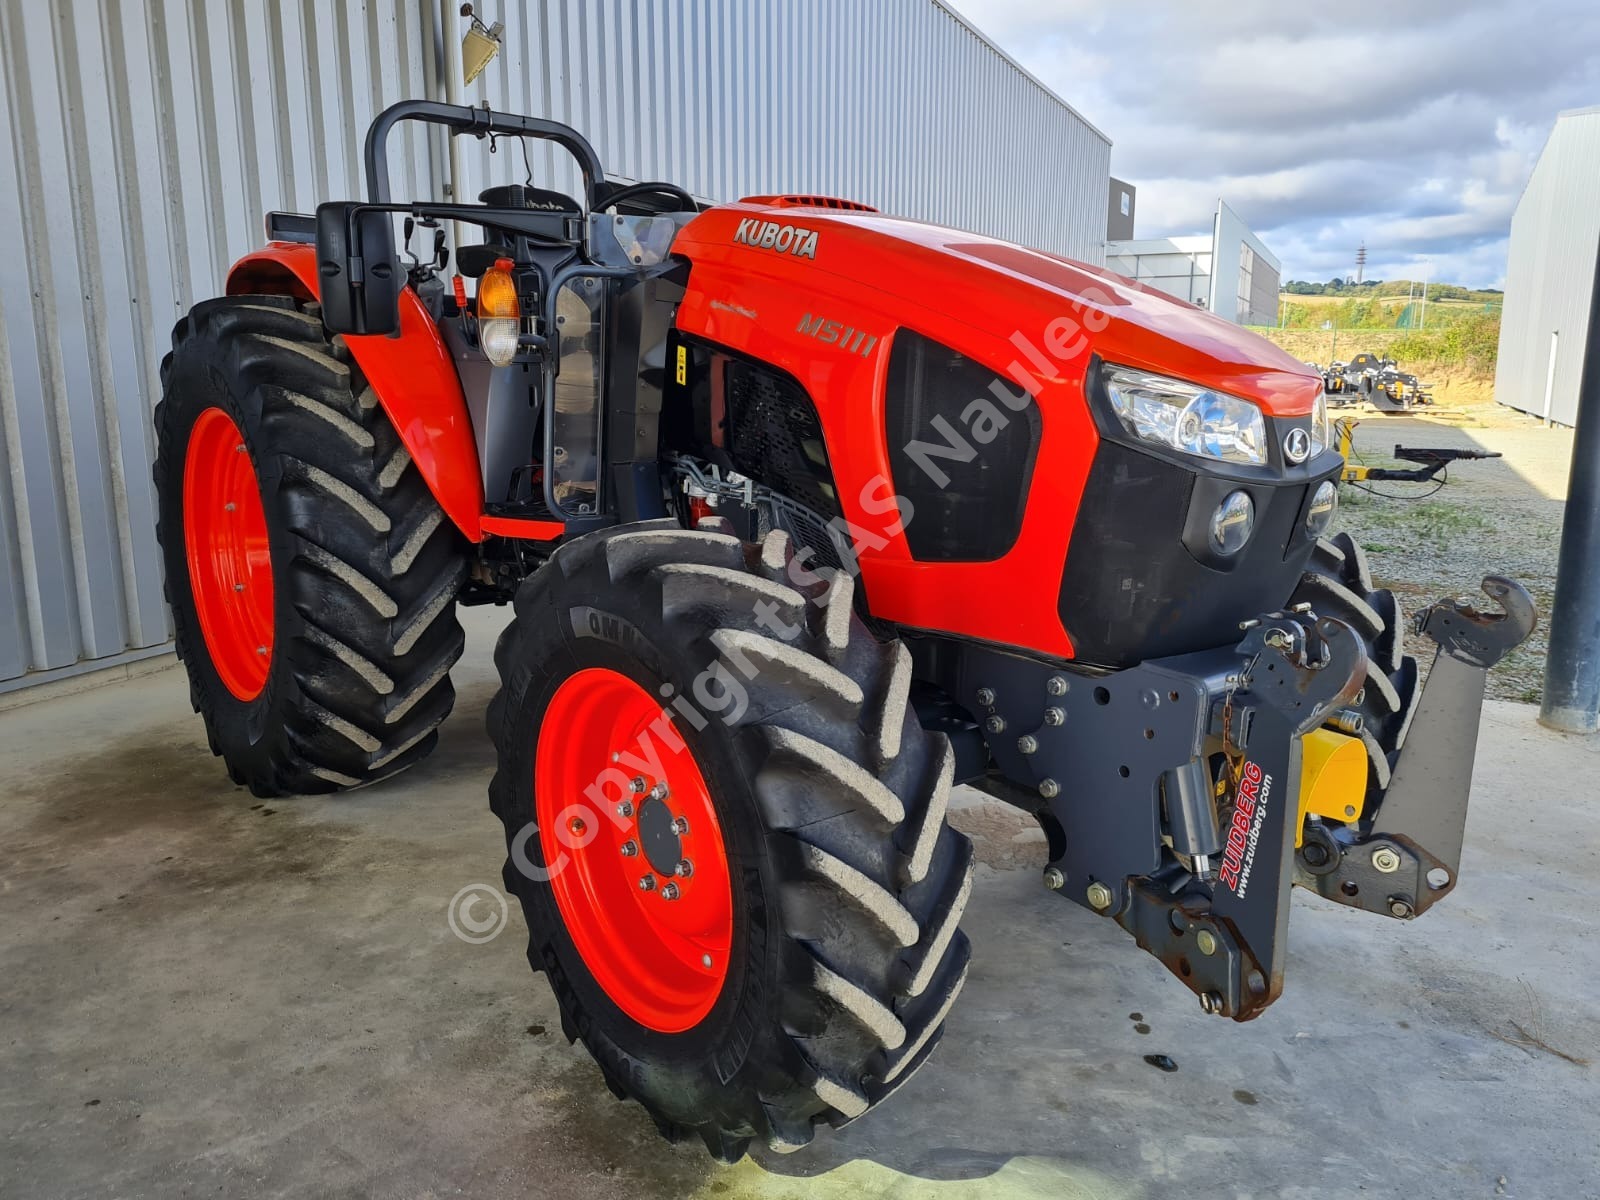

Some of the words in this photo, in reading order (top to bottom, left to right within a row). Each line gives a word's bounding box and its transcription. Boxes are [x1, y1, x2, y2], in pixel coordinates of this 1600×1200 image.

[733, 217, 819, 260] KUBOTA
[1219, 760, 1263, 892] ZUIDBERG
[1237, 774, 1273, 900] www.zuidberg.com
